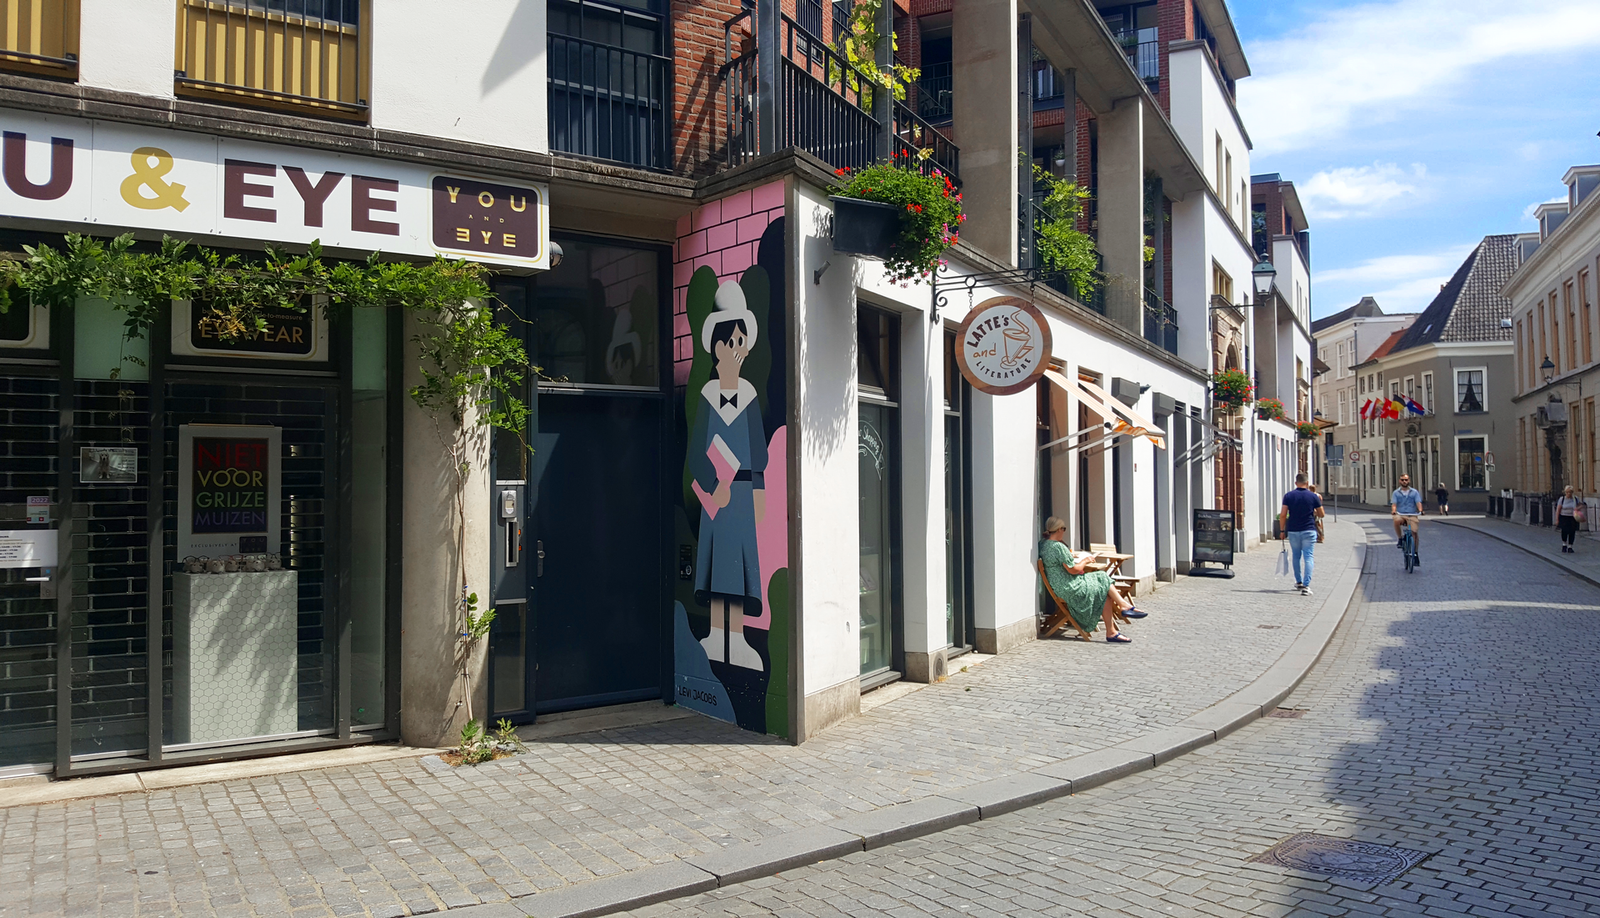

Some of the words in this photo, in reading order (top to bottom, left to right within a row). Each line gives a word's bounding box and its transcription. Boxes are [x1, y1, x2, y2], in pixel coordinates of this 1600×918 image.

[120, 146, 191, 213] &
[224, 158, 400, 236] EYE
[446, 185, 526, 213] YOU
[468, 214, 505, 223] AND
[973, 342, 997, 358] and
[976, 358, 1031, 379] LITERATURE
[198, 443, 266, 468] NIET
[197, 469, 264, 488] VOOR
[196, 491, 265, 508] GRIJZE
[195, 511, 266, 526] MUIZEN
[678, 685, 692, 699] LEVI
[692, 688, 718, 706] JACOBS
